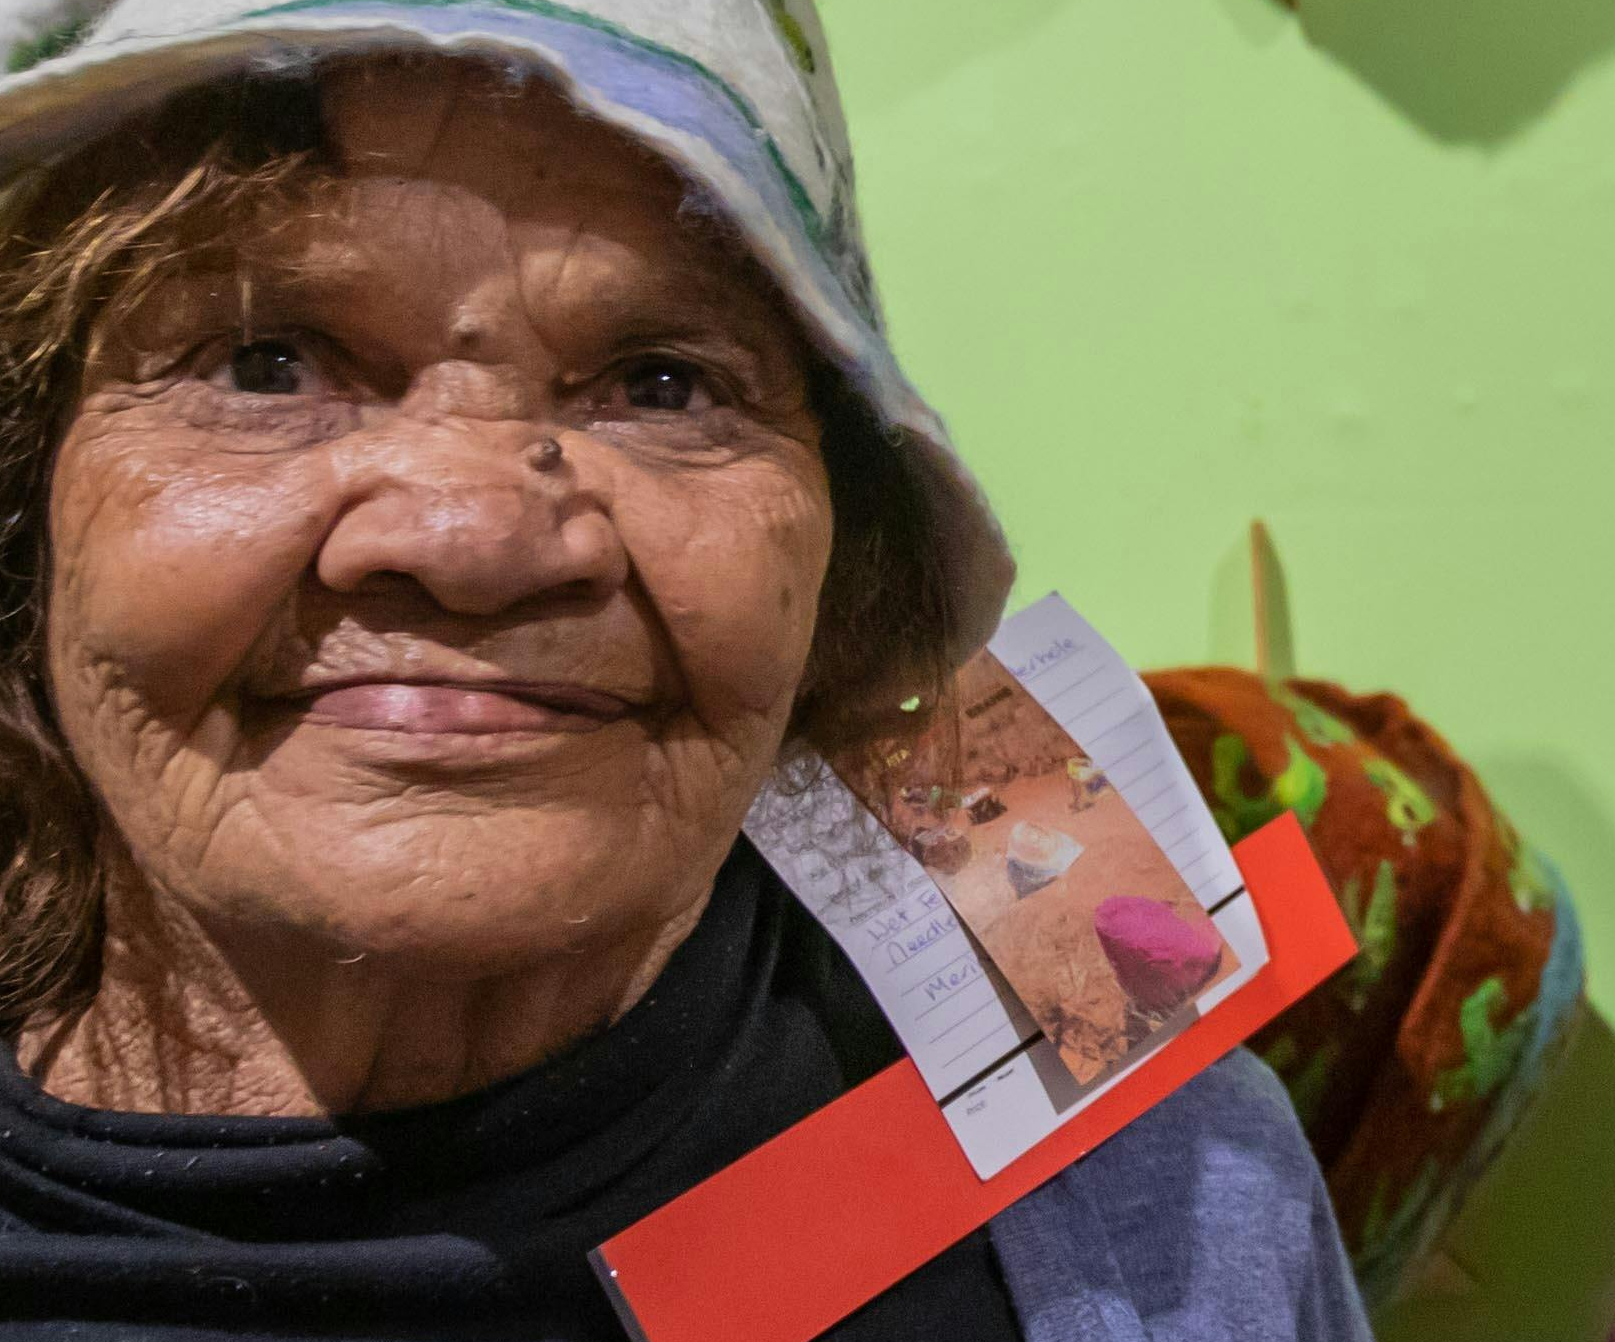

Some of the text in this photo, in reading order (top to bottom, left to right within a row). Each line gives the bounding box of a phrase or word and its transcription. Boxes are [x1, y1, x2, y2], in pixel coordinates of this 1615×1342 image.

[1009, 638, 1076, 677] erhole
[917, 888, 941, 910] Fe
[924, 961, 979, 1001] Meri
